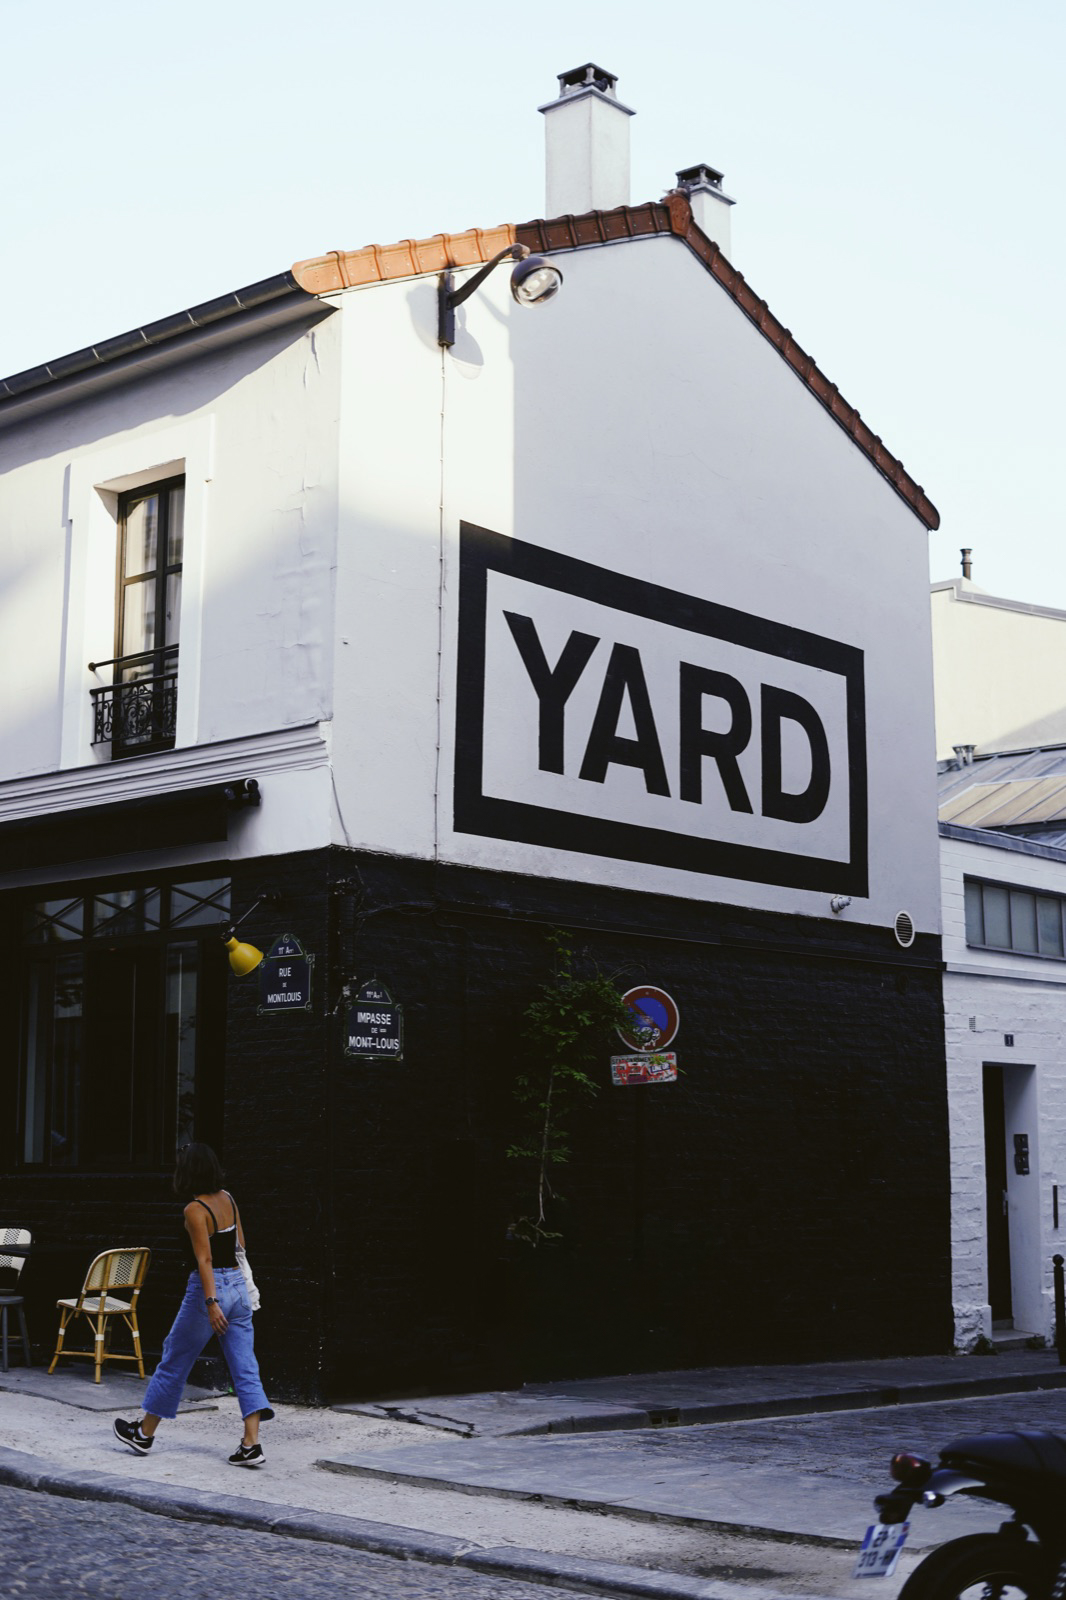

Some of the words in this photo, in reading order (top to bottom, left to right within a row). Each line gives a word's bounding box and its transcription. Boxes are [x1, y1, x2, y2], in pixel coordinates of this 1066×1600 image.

[502, 609, 831, 825] YARD
[278, 967, 292, 977] RUE
[267, 991, 302, 1004] MONTLOUIS
[357, 1011, 392, 1025] IMPASSE
[348, 1035, 400, 1050] MONT-LOUIS
